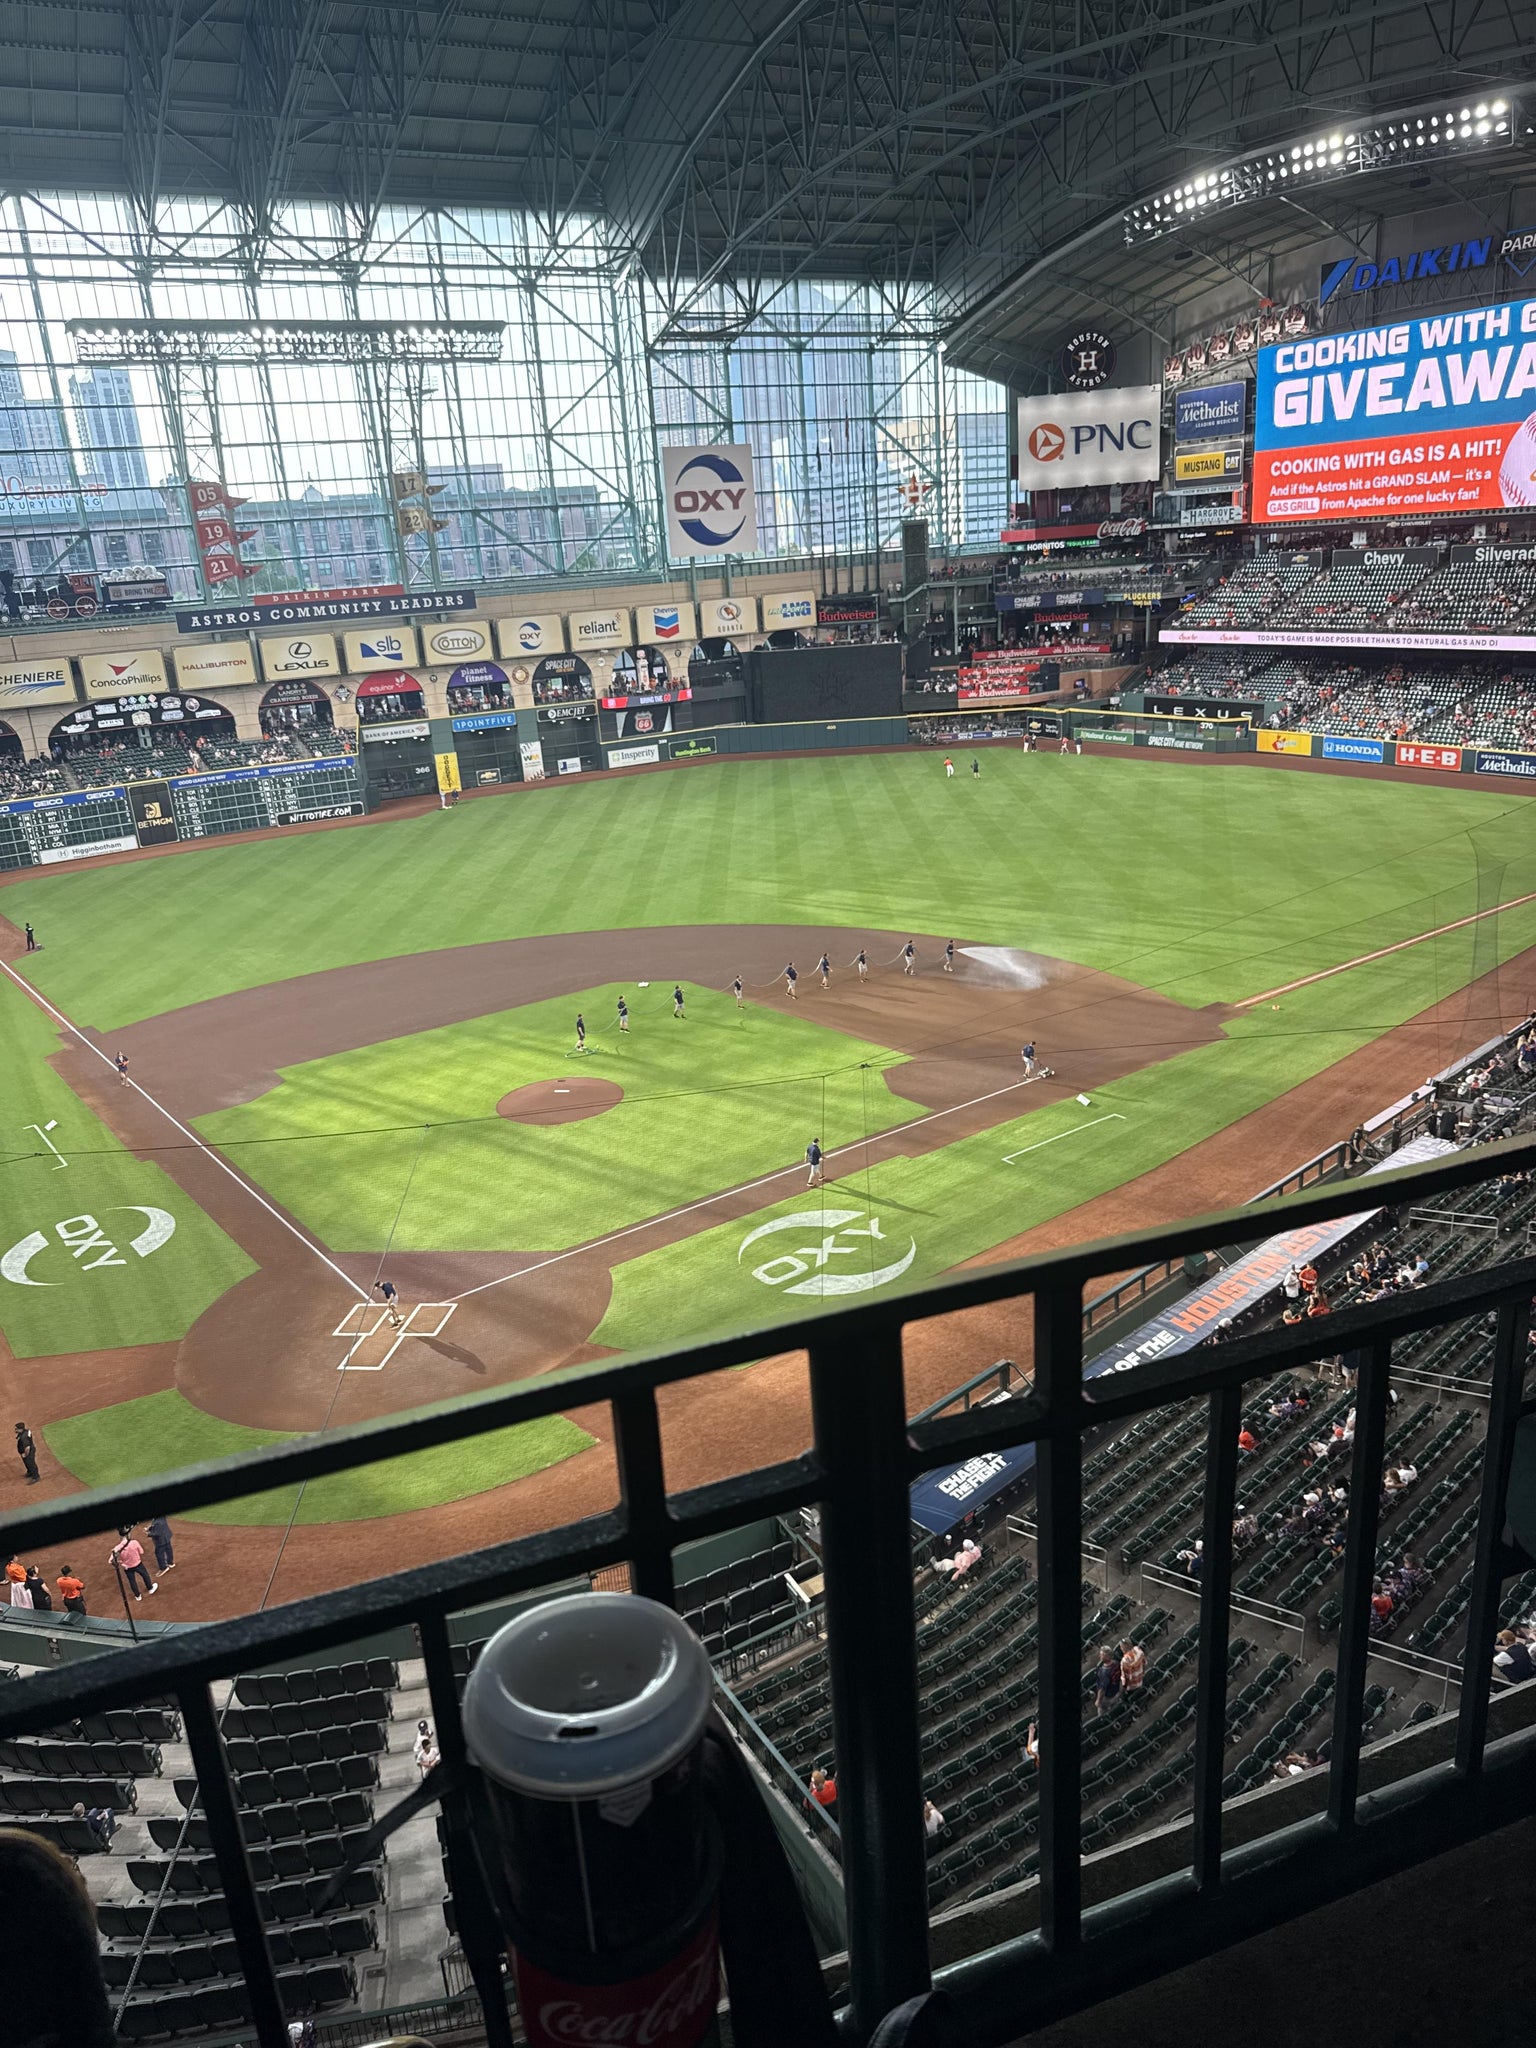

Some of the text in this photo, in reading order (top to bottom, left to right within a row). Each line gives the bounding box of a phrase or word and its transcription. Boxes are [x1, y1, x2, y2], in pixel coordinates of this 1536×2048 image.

[1352, 236, 1493, 291] DAIKIN
[1067, 333, 1109, 351] HOUSTON
[1276, 307, 1511, 373] COOKING WITH
[1069, 371, 1107, 387] ASTROS
[1180, 401, 1203, 410] HOUSTON
[1180, 400, 1239, 423] Methodist
[1071, 420, 1151, 454] PNC
[1184, 456, 1240, 472] MUSTANG CAT
[1270, 439, 1502, 477] COOKING WITH GAS IS A HIT!
[400, 478, 416, 492] 17
[1270, 468, 1492, 497] And if the Astros hit a GRAND SLAM it's a
[25, 483, 108, 500] CRAWORD
[197, 487, 216, 502] 05
[51, 498, 100, 508] LIVNG
[675, 488, 747, 513] OXY
[1269, 487, 1480, 513] GAS GRILL from Apache for one lucky fan!
[405, 515, 420, 527] 22
[1190, 508, 1235, 524] HARGROVE
[205, 525, 223, 539] 19
[1027, 541, 1065, 551] HORNITOS
[1364, 551, 1405, 567] Chevy
[211, 560, 228, 574] 21
[272, 588, 379, 602] DAIKIN PARK
[192, 595, 464, 627] ASTROS COMMUNITY LEADERS
[818, 611, 876, 622] Budweiser
[1034, 612, 1089, 623] Budweiser
[579, 621, 617, 634] reliant
[718, 624, 743, 633] QUANTA
[520, 632, 541, 640] OXY
[1336, 636, 1370, 644] POSSIBLE
[1371, 637, 1400, 645] THANKS
[1402, 637, 1413, 645] TO
[1451, 638, 1468, 646] GAS
[1469, 638, 1487, 646] AND
[377, 636, 401, 653] slb
[438, 636, 477, 650] COTTON
[1064, 644, 1100, 653] Budweiser
[998, 649, 1039, 658] Budweiser
[182, 659, 247, 671] HALLIBURTON
[274, 660, 329, 671] LEXUS
[545, 660, 563, 670] SPACE
[563, 659, 576, 668] CITY
[461, 666, 488, 678] planet
[465, 672, 493, 683] fitness
[91, 673, 162, 690] ConocoPhillips
[370, 684, 394, 692] equinor
[979, 688, 1021, 697] Budweiser
[1153, 705, 1253, 720] LEXUS
[456, 716, 513, 728] 1POINTFIVE
[638, 720, 649, 728] 66
[1200, 722, 1213, 730] 370
[388, 728, 415, 736] AMERICA
[1085, 732, 1104, 740] National
[1148, 736, 1164, 746] SPACE
[1164, 736, 1175, 747] CITY
[621, 748, 655, 760] Insperity
[1335, 744, 1381, 756] HONDA
[1400, 747, 1457, 766] H-E-B
[86, 790, 115, 800] GEICO
[33, 798, 64, 807] GEICO
[289, 806, 352, 824] NITTOTIRE.COM
[138, 817, 173, 829] BETMGM
[72, 842, 122, 855] Higginbotham
[55, 1214, 128, 1271] OXY
[752, 1217, 887, 1286] OXY
[1136, 1329, 1176, 1358] THE
[1169, 1252, 1291, 1333] HOUSTON
[938, 1456, 987, 1494] CHASE
[948, 1455, 1007, 1499] THE FIGHT
